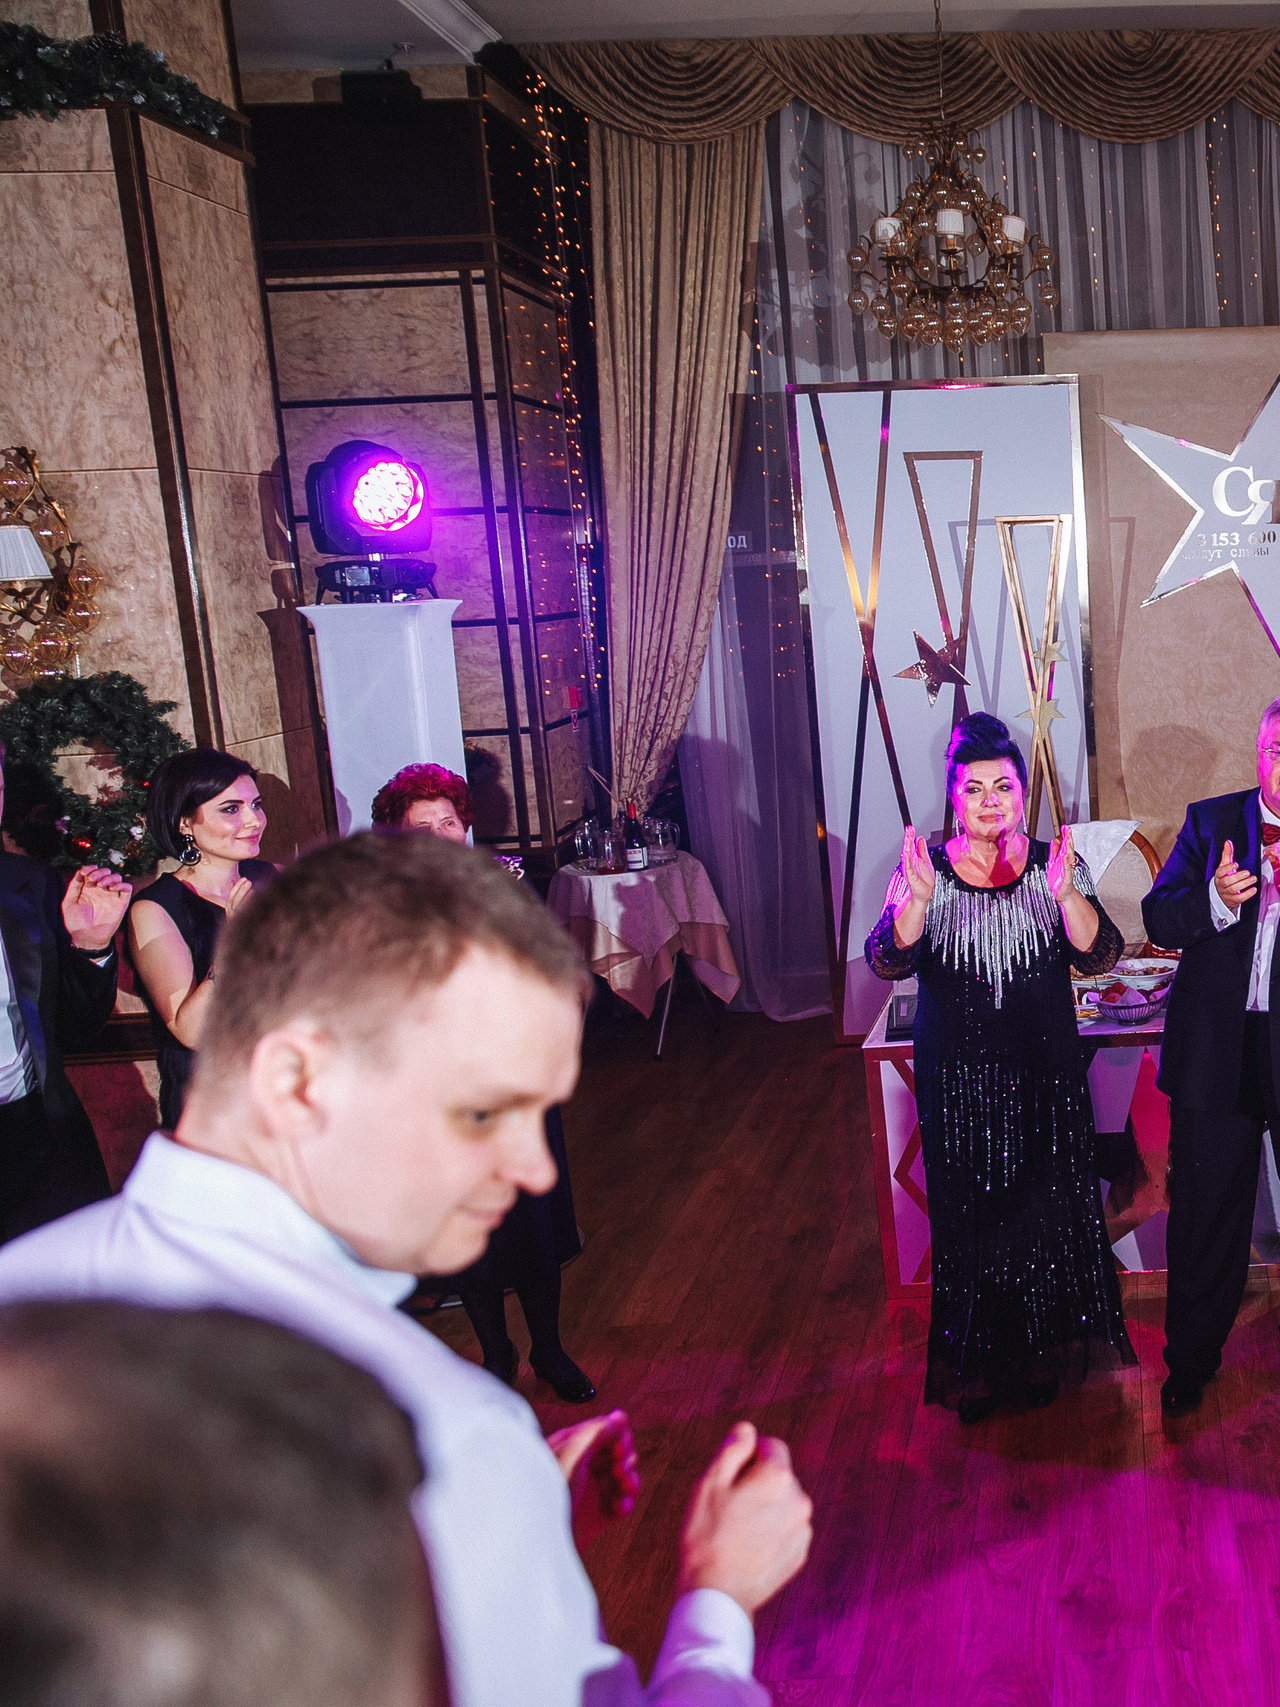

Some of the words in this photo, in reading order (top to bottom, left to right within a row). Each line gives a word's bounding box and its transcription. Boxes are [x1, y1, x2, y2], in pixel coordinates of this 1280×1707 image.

[725, 535, 747, 549] ОД
[1211, 532, 1241, 547] 153
[1247, 530, 1277, 545] 600
[1230, 547, 1269, 559] слвы
